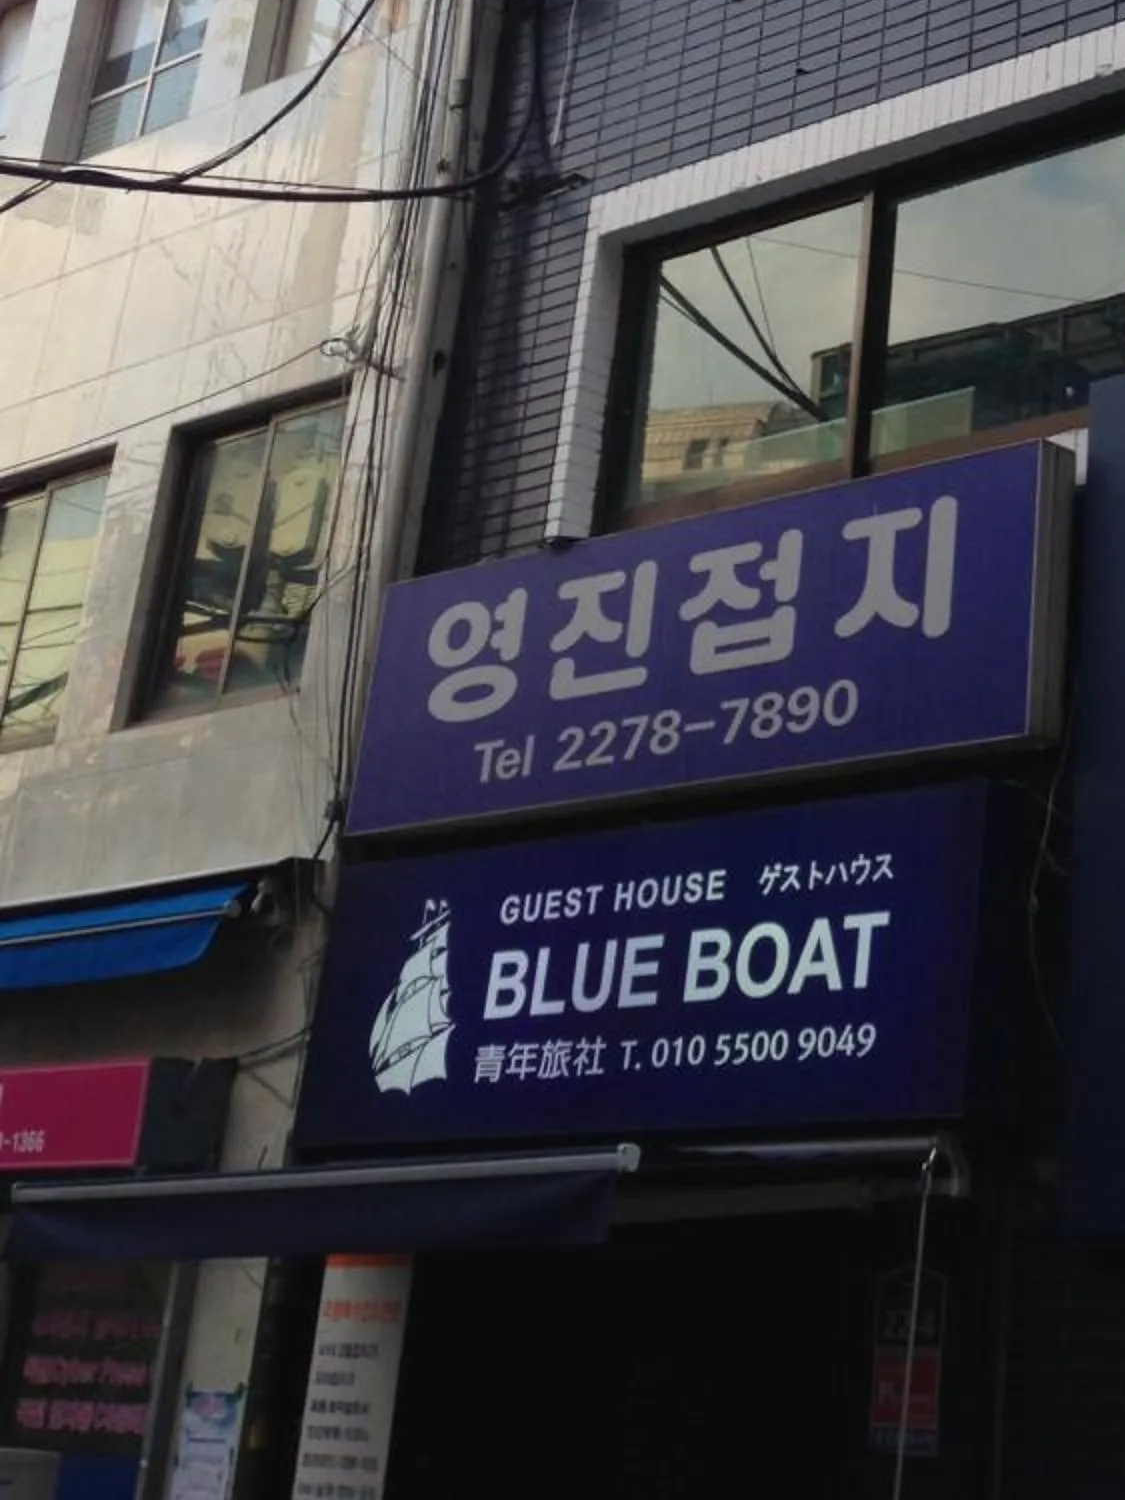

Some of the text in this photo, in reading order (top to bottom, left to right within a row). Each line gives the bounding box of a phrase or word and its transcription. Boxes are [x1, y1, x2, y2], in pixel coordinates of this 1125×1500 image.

[427, 496, 959, 723] 영진접지
[475, 679, 859, 783] Tel 2278-7890
[501, 853, 894, 926] GUEST HOUSE ゲストハウス
[483, 911, 891, 1021] BLUE BOAT
[473, 1023, 877, 1084] 青年旅社 T. 010 5500 9049
